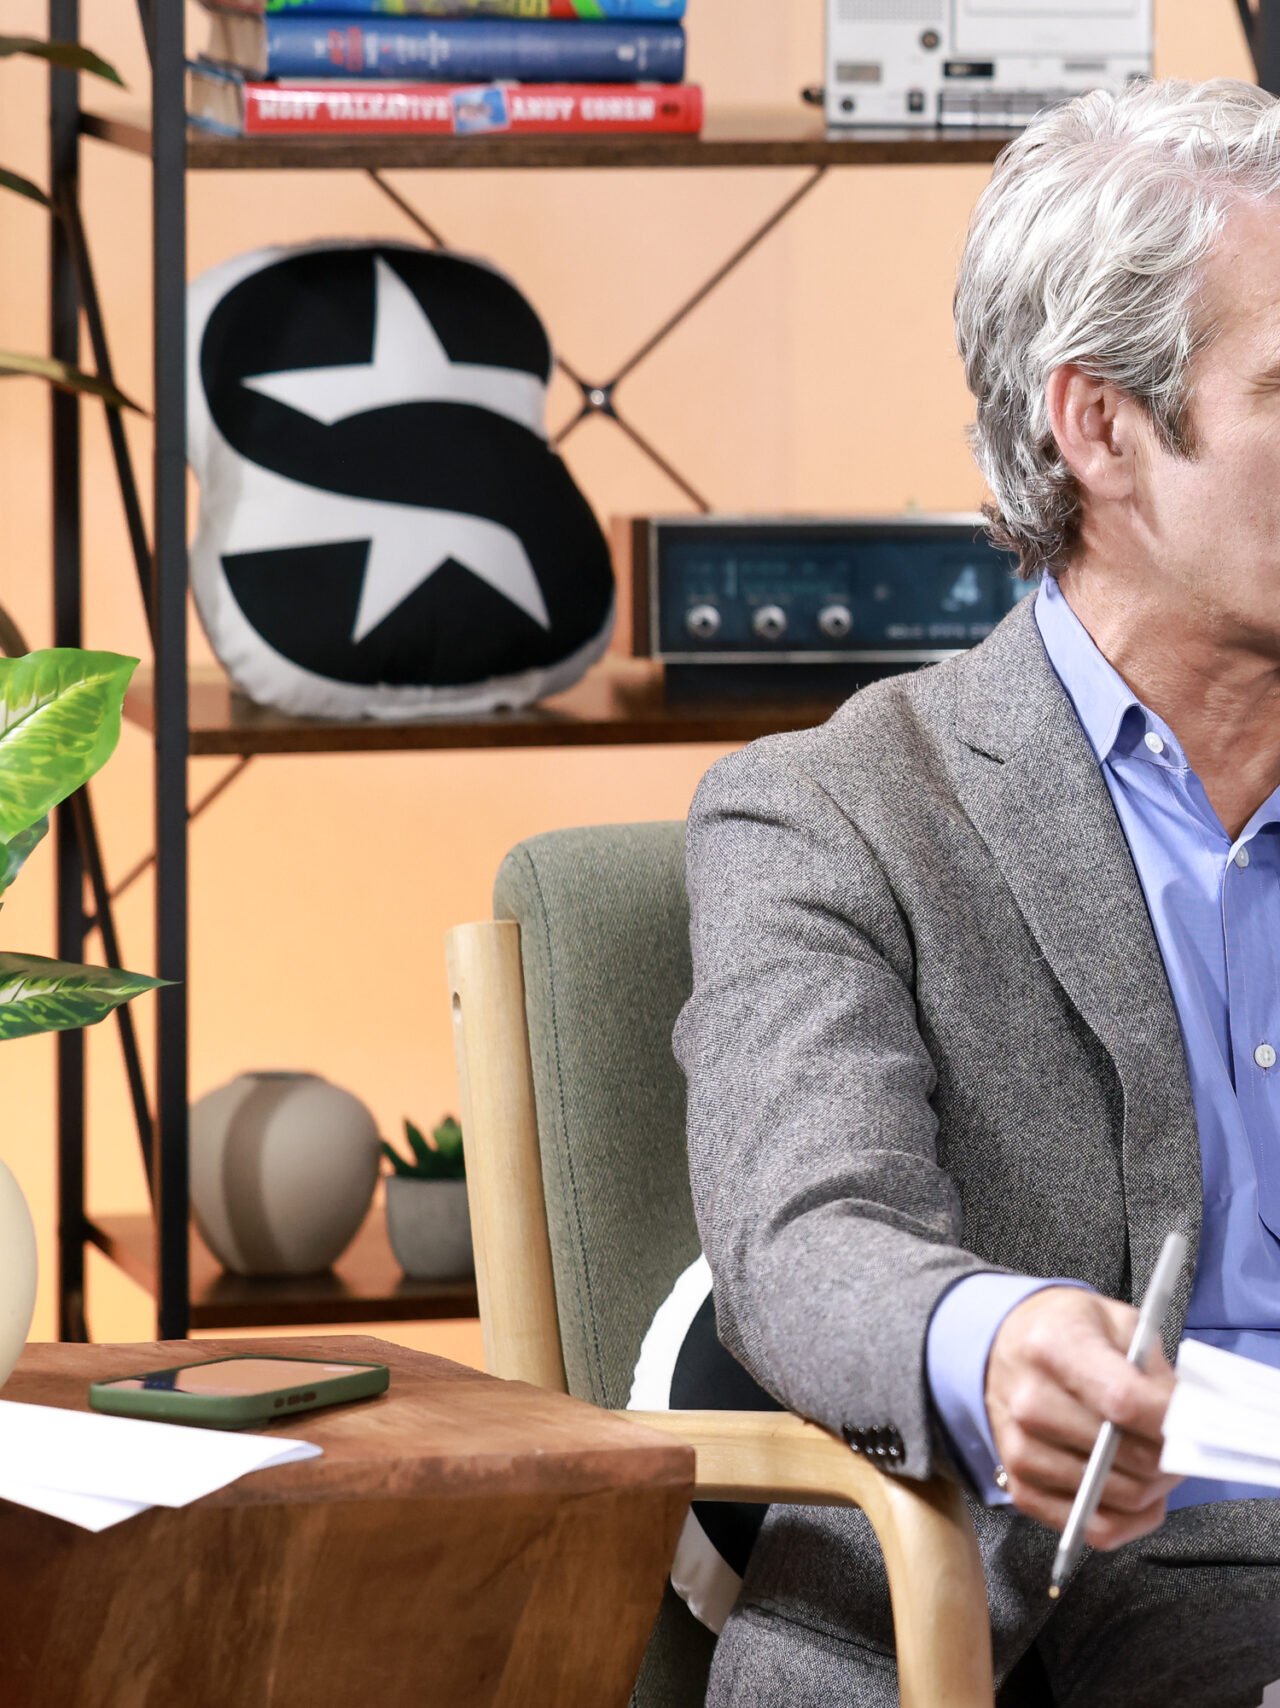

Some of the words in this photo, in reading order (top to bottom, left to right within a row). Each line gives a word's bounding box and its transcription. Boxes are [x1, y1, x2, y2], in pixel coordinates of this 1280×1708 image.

[326, 96, 449, 120] TALKATIVE
[511, 97, 573, 120] ANDY
[580, 96, 656, 120] COHEN
